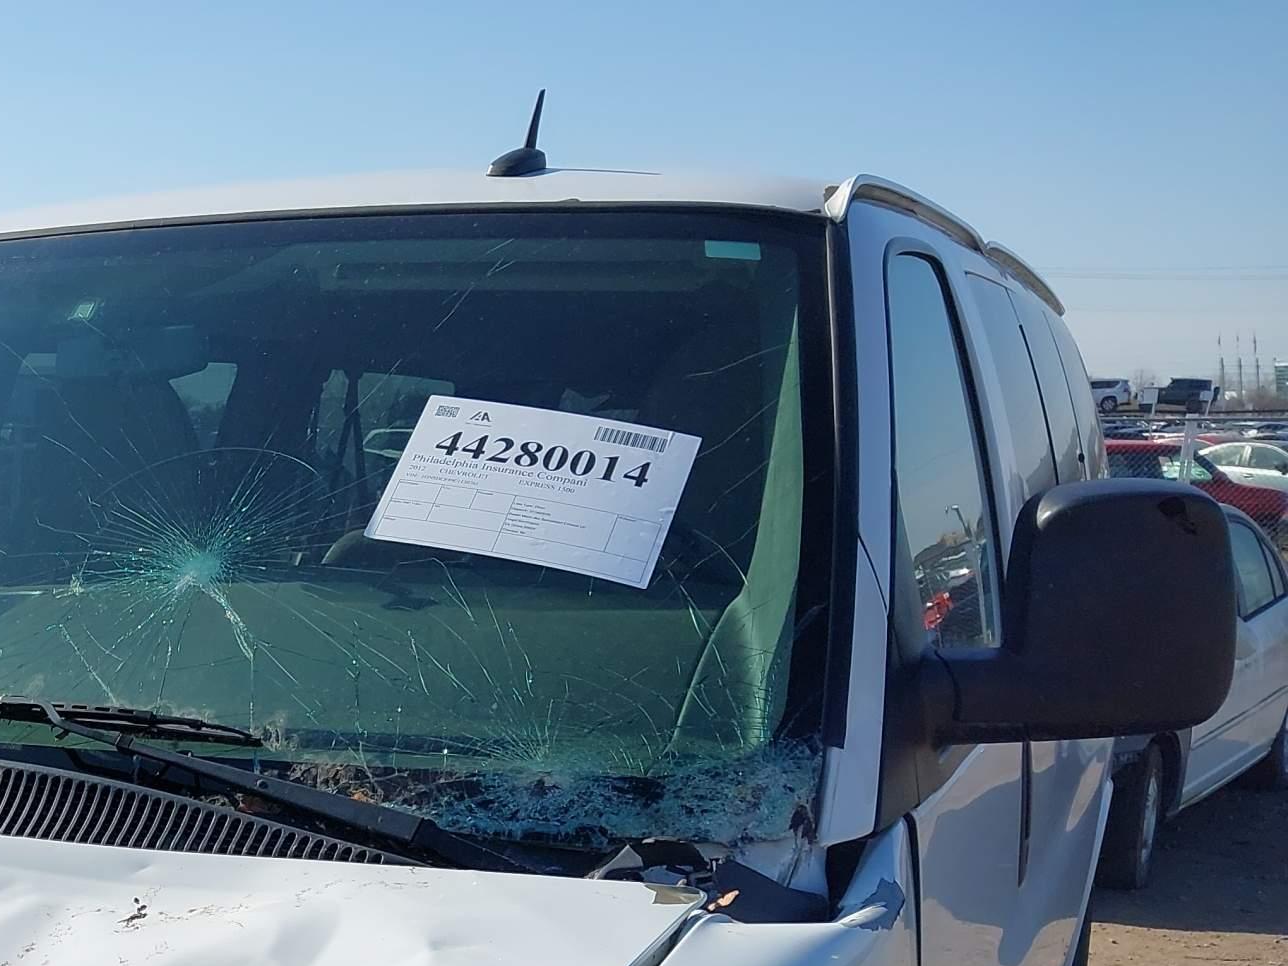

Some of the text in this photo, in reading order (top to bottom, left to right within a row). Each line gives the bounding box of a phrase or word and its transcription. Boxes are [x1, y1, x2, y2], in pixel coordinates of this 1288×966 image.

[412, 454, 588, 487] Philadelphia Insurance Compani
[435, 431, 651, 488] 44280014
[408, 464, 426, 472] 2012
[439, 468, 489, 480] CHEVROLET
[518, 478, 555, 490] EXPRESS
[557, 485, 576, 494] 1500
